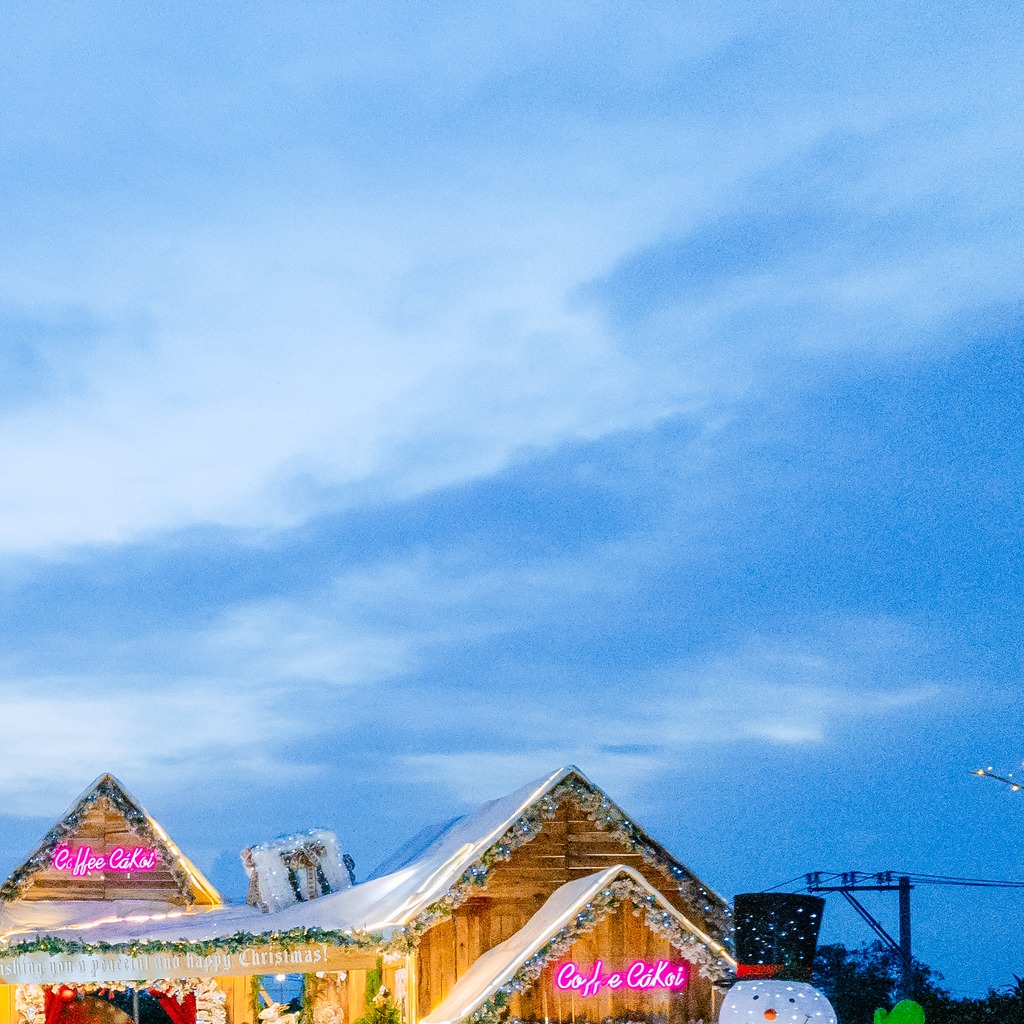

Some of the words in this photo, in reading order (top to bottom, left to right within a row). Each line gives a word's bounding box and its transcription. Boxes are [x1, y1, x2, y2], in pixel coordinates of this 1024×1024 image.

[55, 847, 106, 876] Coffee
[186, 952, 232, 974] happy
[239, 944, 329, 968] Christmas!
